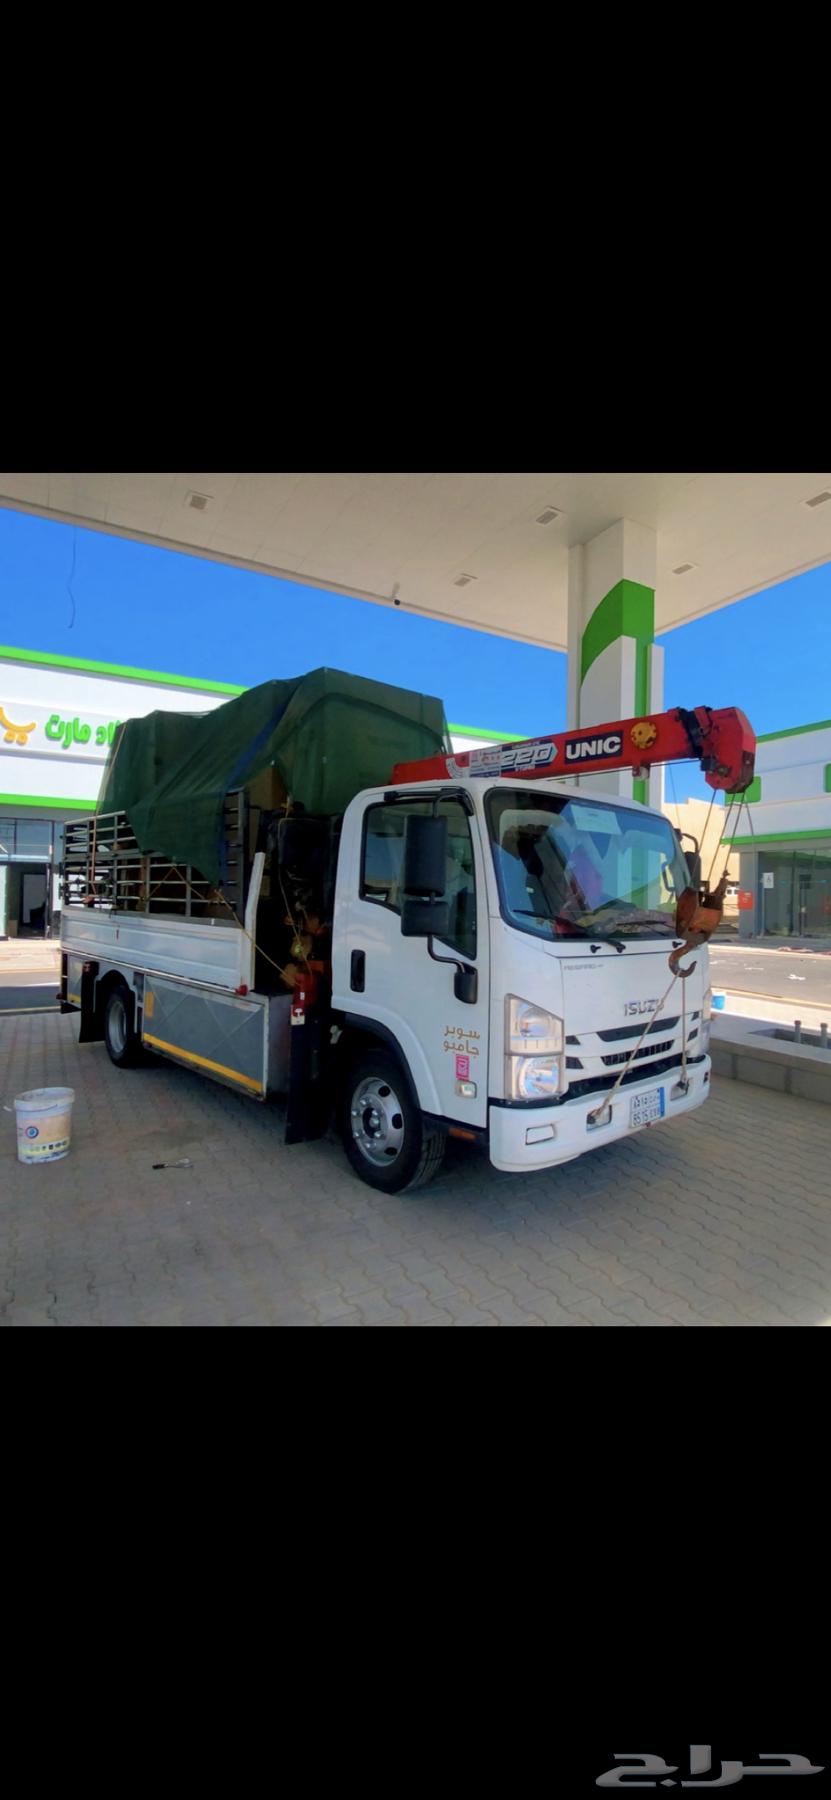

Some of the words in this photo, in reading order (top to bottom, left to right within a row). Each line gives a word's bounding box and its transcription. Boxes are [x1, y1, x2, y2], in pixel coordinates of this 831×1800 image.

[45, 714, 91, 749] مارت
[566, 736, 621, 760] UNIC
[444, 1025, 480, 1040] سوبر
[443, 1040, 480, 1059] جامبو
